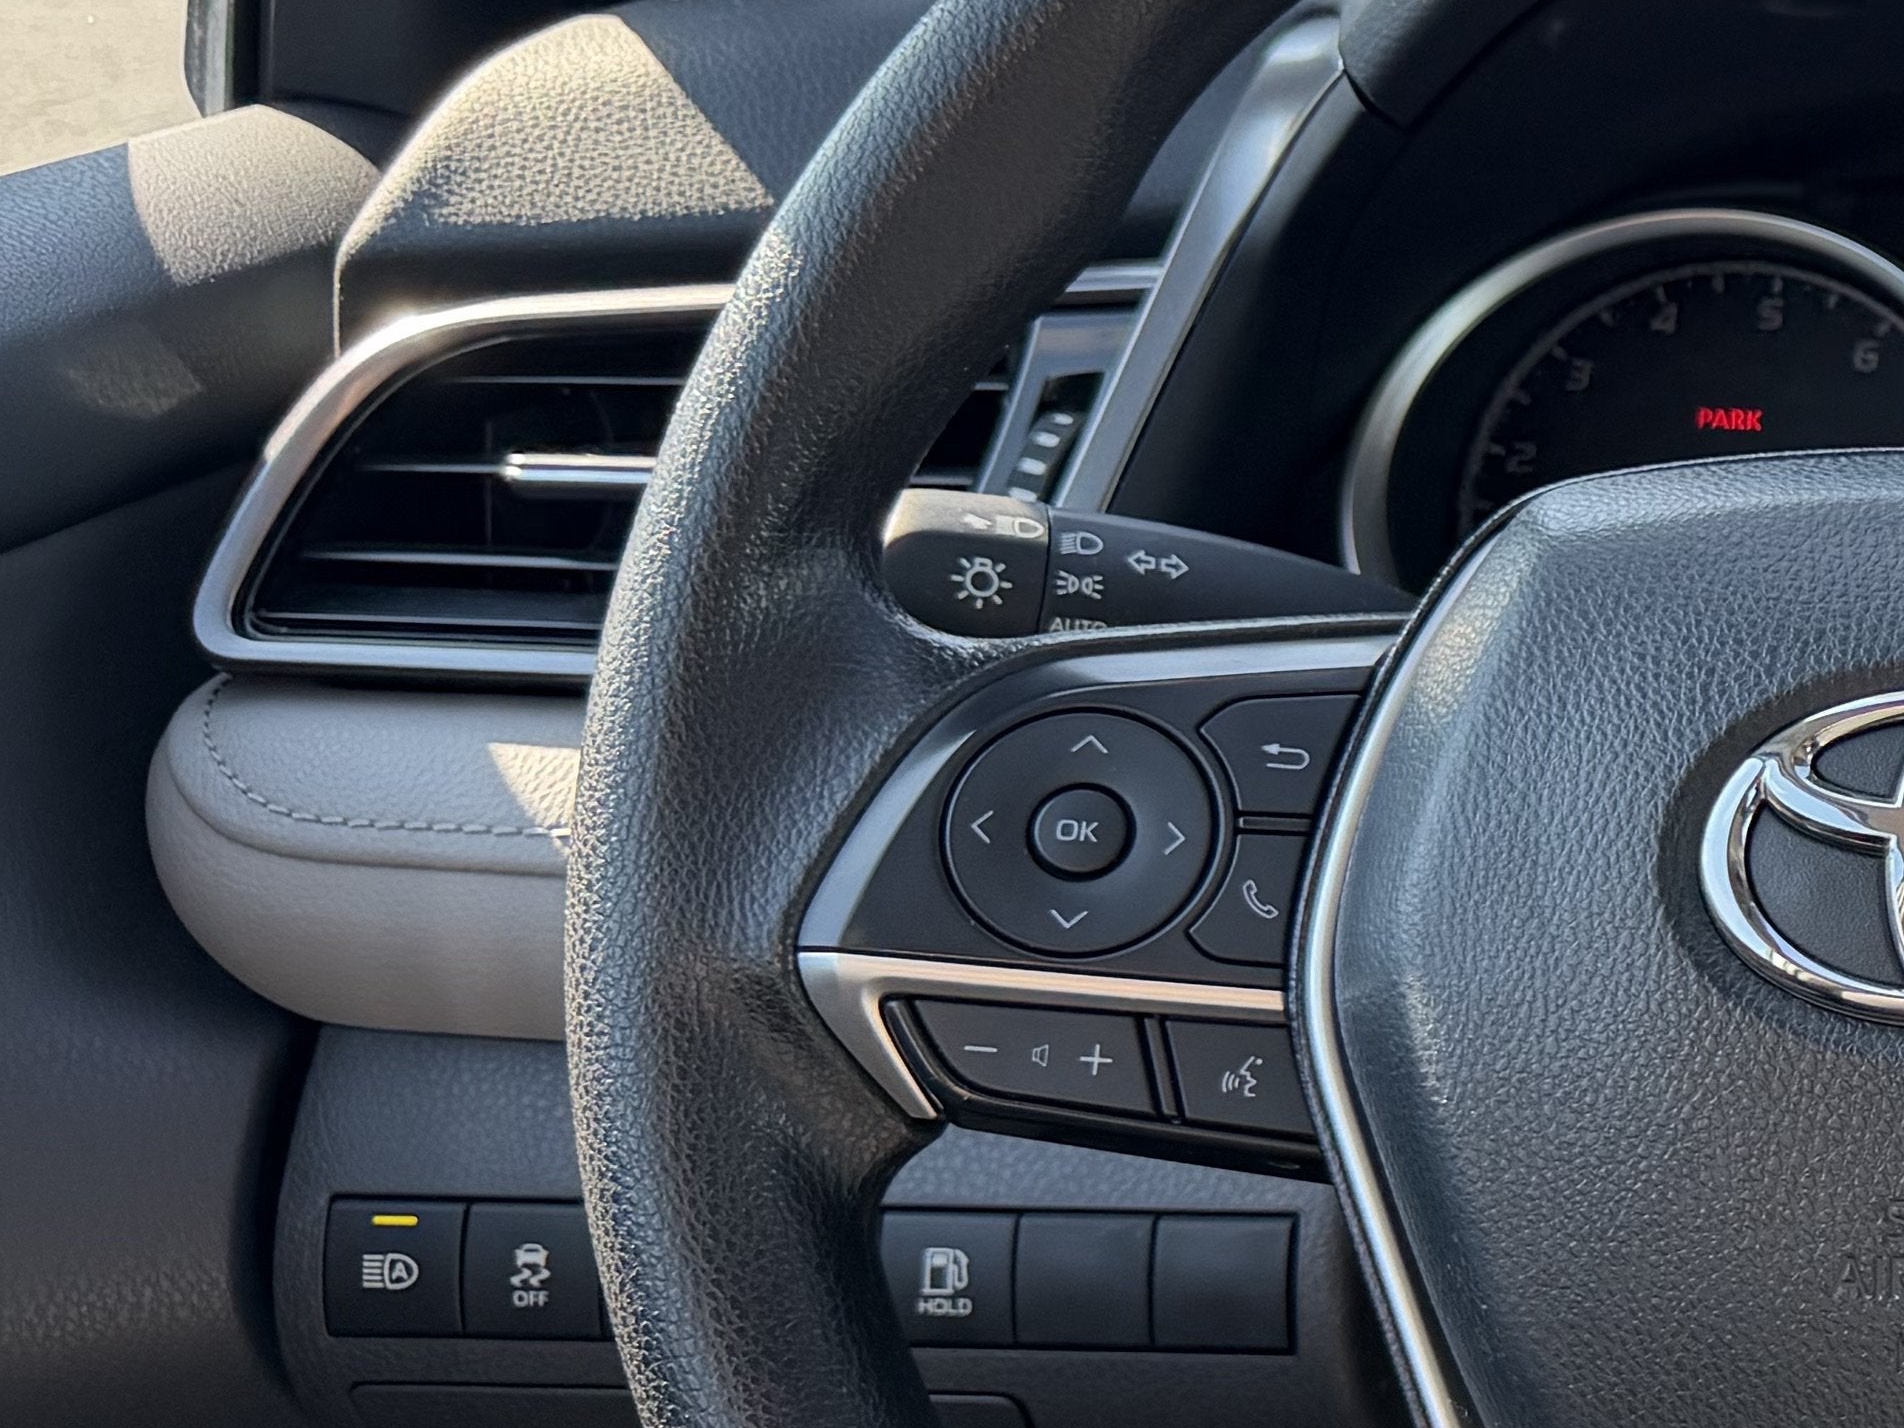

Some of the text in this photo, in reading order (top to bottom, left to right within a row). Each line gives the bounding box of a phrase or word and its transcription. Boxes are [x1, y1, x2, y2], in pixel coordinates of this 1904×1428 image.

[1757, 298, 1786, 331] 5
[1852, 340, 1880, 372] 6
[1565, 357, 1594, 391] 3
[1696, 407, 1763, 432] PARK
[1055, 817, 1098, 843] OK
[513, 1290, 549, 1308] OFF
[918, 1298, 973, 1317] HOLD
